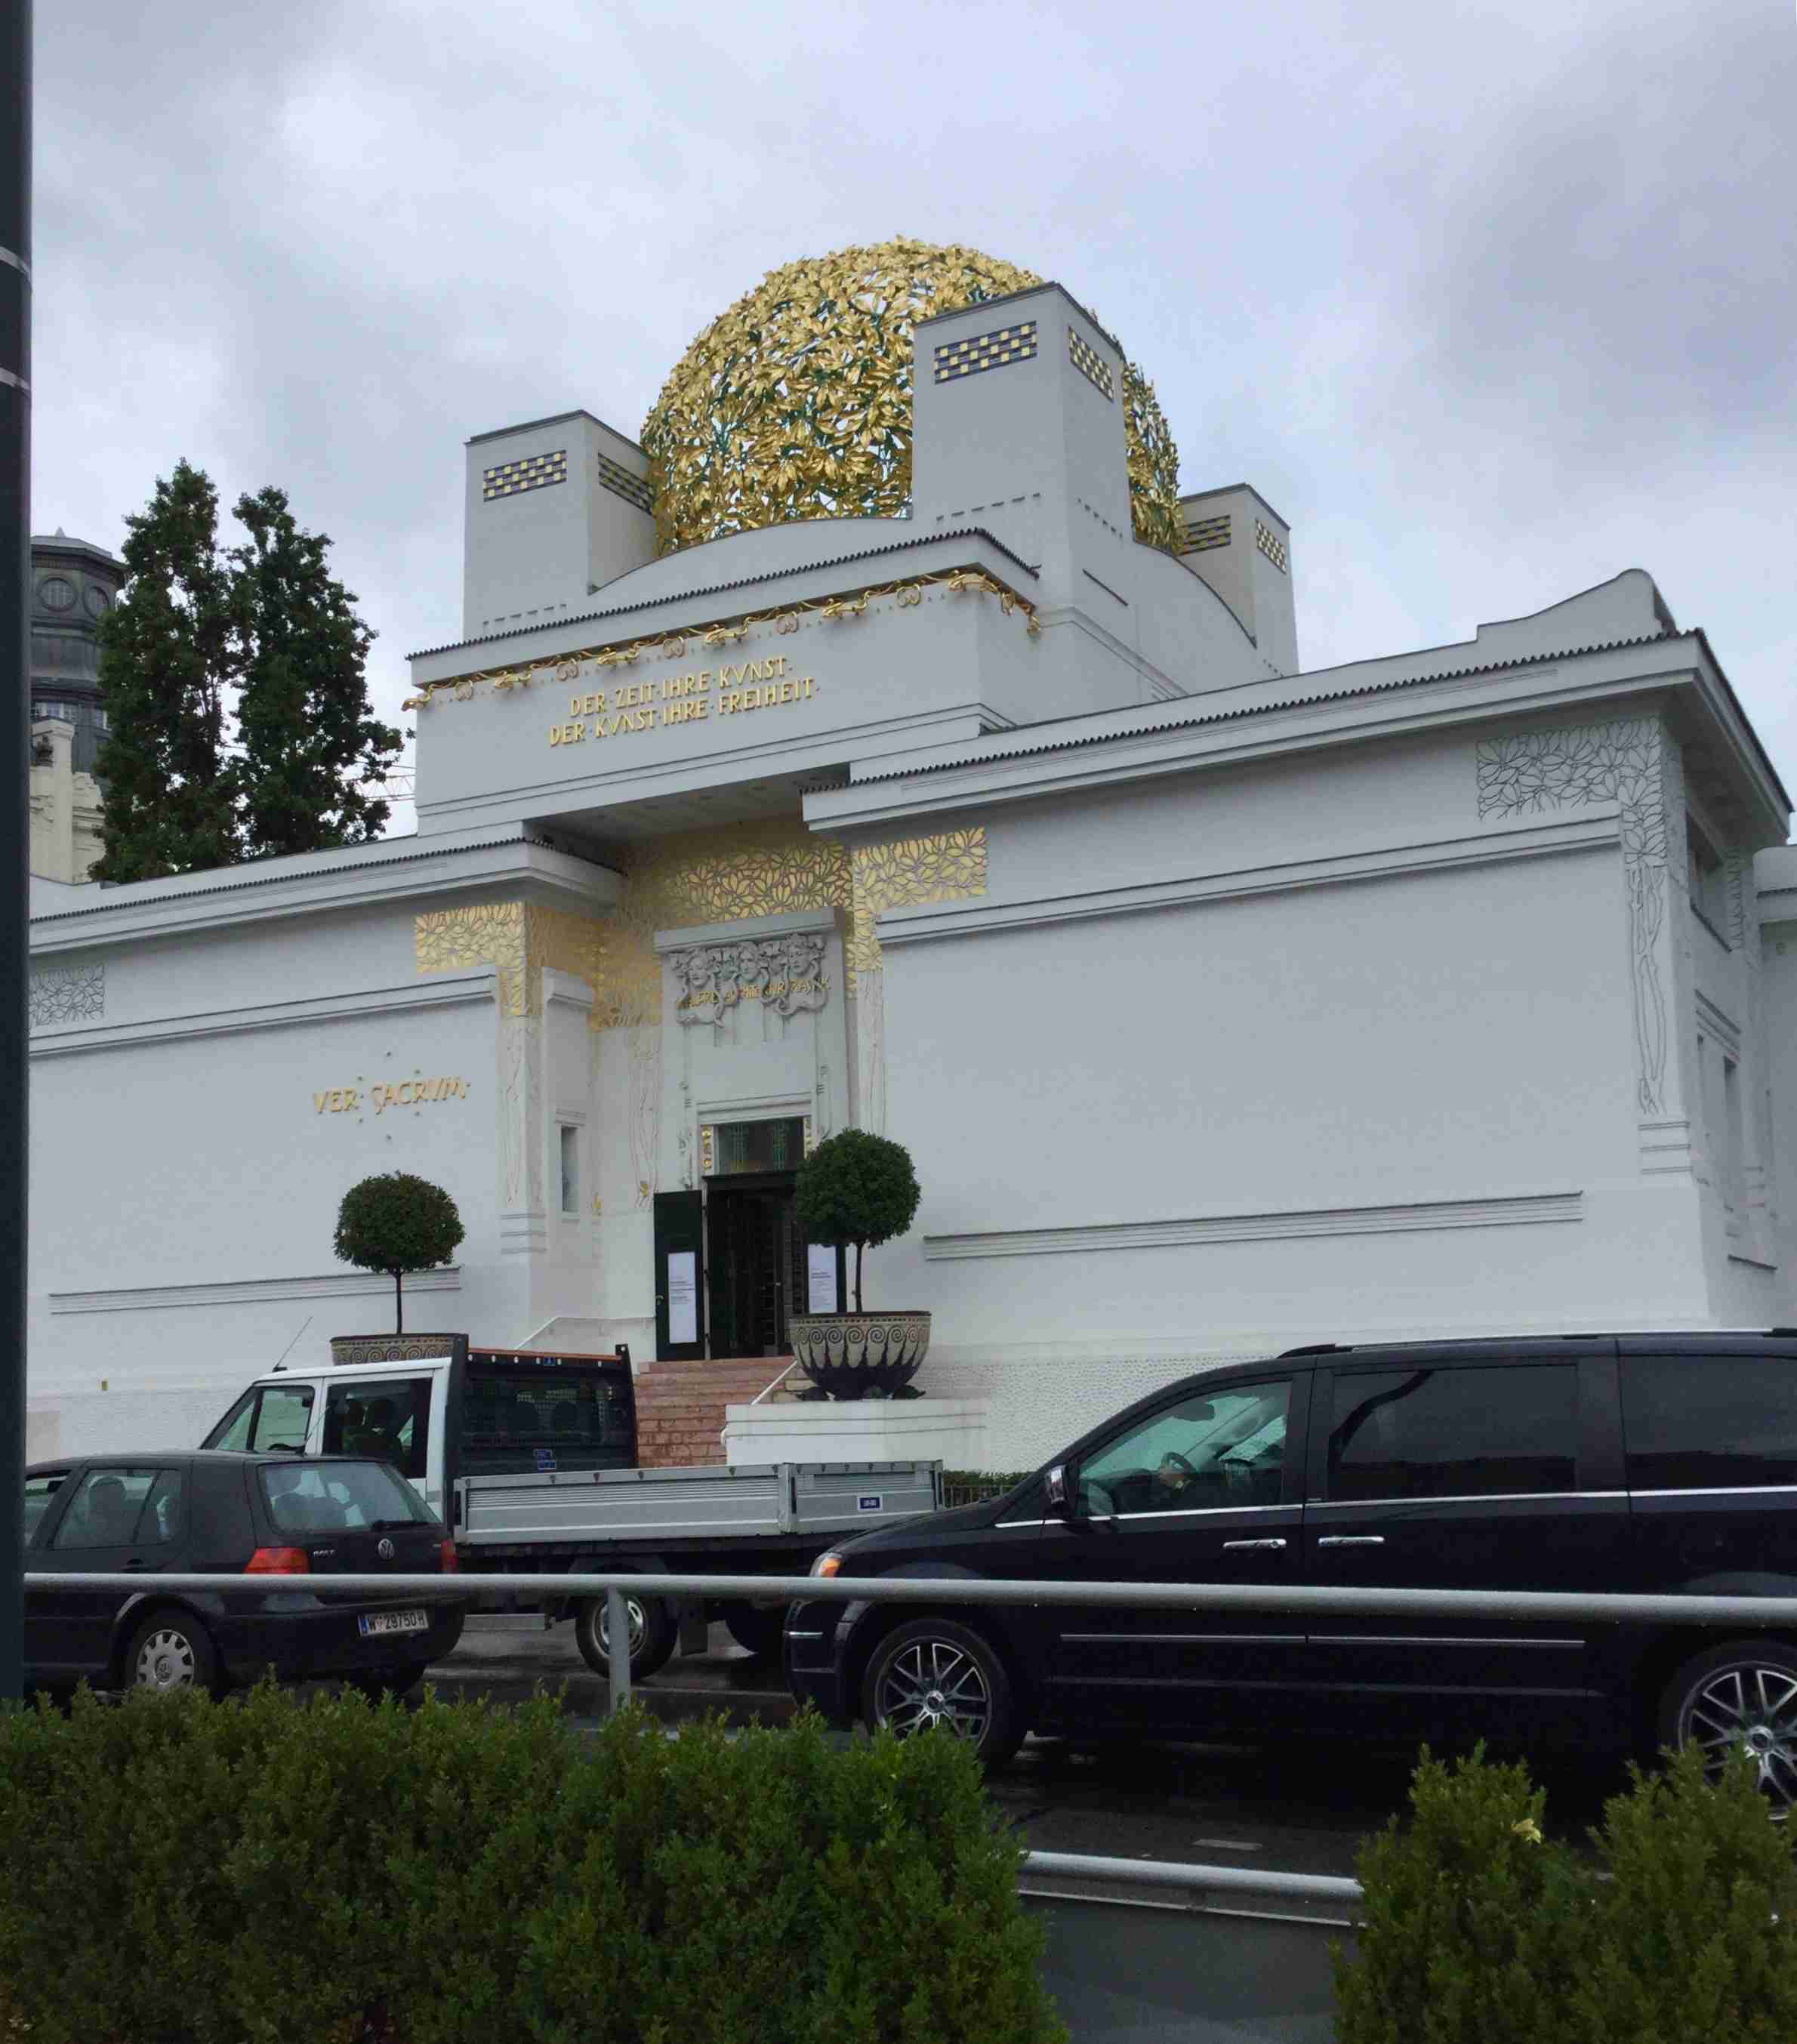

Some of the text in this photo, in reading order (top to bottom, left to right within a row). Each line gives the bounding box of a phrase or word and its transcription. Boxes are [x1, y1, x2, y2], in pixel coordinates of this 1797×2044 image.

[550, 723, 586, 747] DER
[663, 698, 708, 726] IHRE
[718, 677, 815, 715] FREIHEIT
[569, 693, 606, 717] DER
[615, 682, 656, 710] ZEIT
[661, 672, 712, 700] IHRE
[313, 1087, 357, 1114] VER
